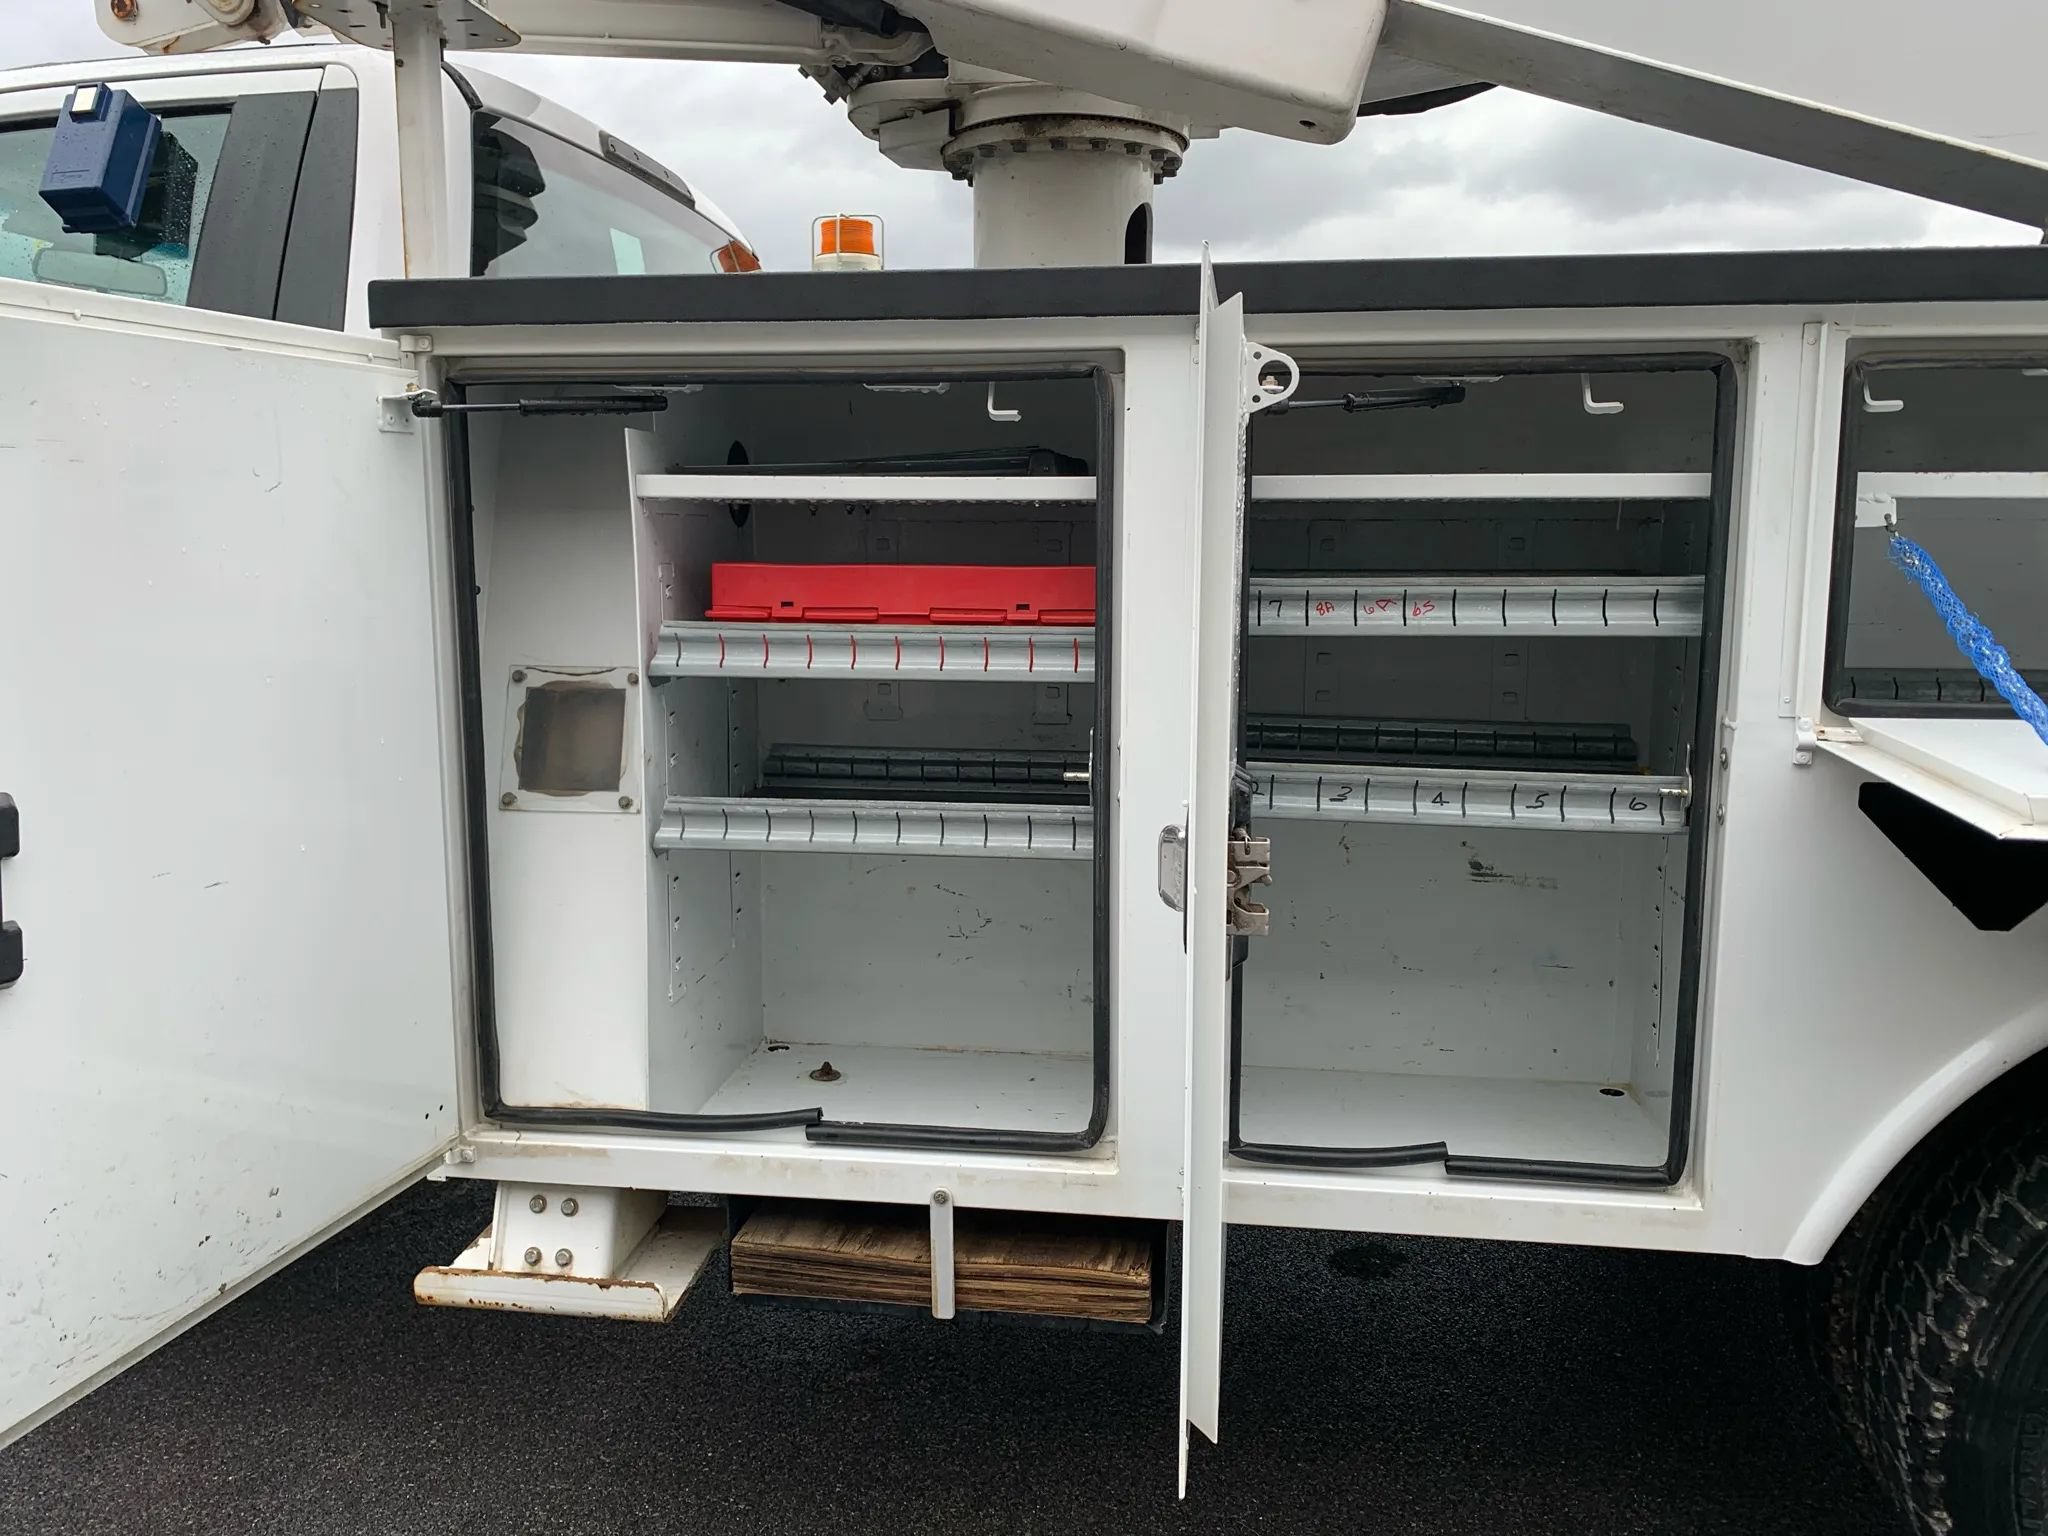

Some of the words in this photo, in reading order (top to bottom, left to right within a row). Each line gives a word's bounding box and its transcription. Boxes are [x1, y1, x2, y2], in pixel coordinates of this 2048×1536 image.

[1268, 599, 1283, 618] 7
[1315, 600, 1336, 617] 8A
[1328, 785, 1353, 802] 3
[1431, 791, 1451, 807] 4
[1525, 792, 1550, 809] 5
[1628, 796, 1648, 811] 6
